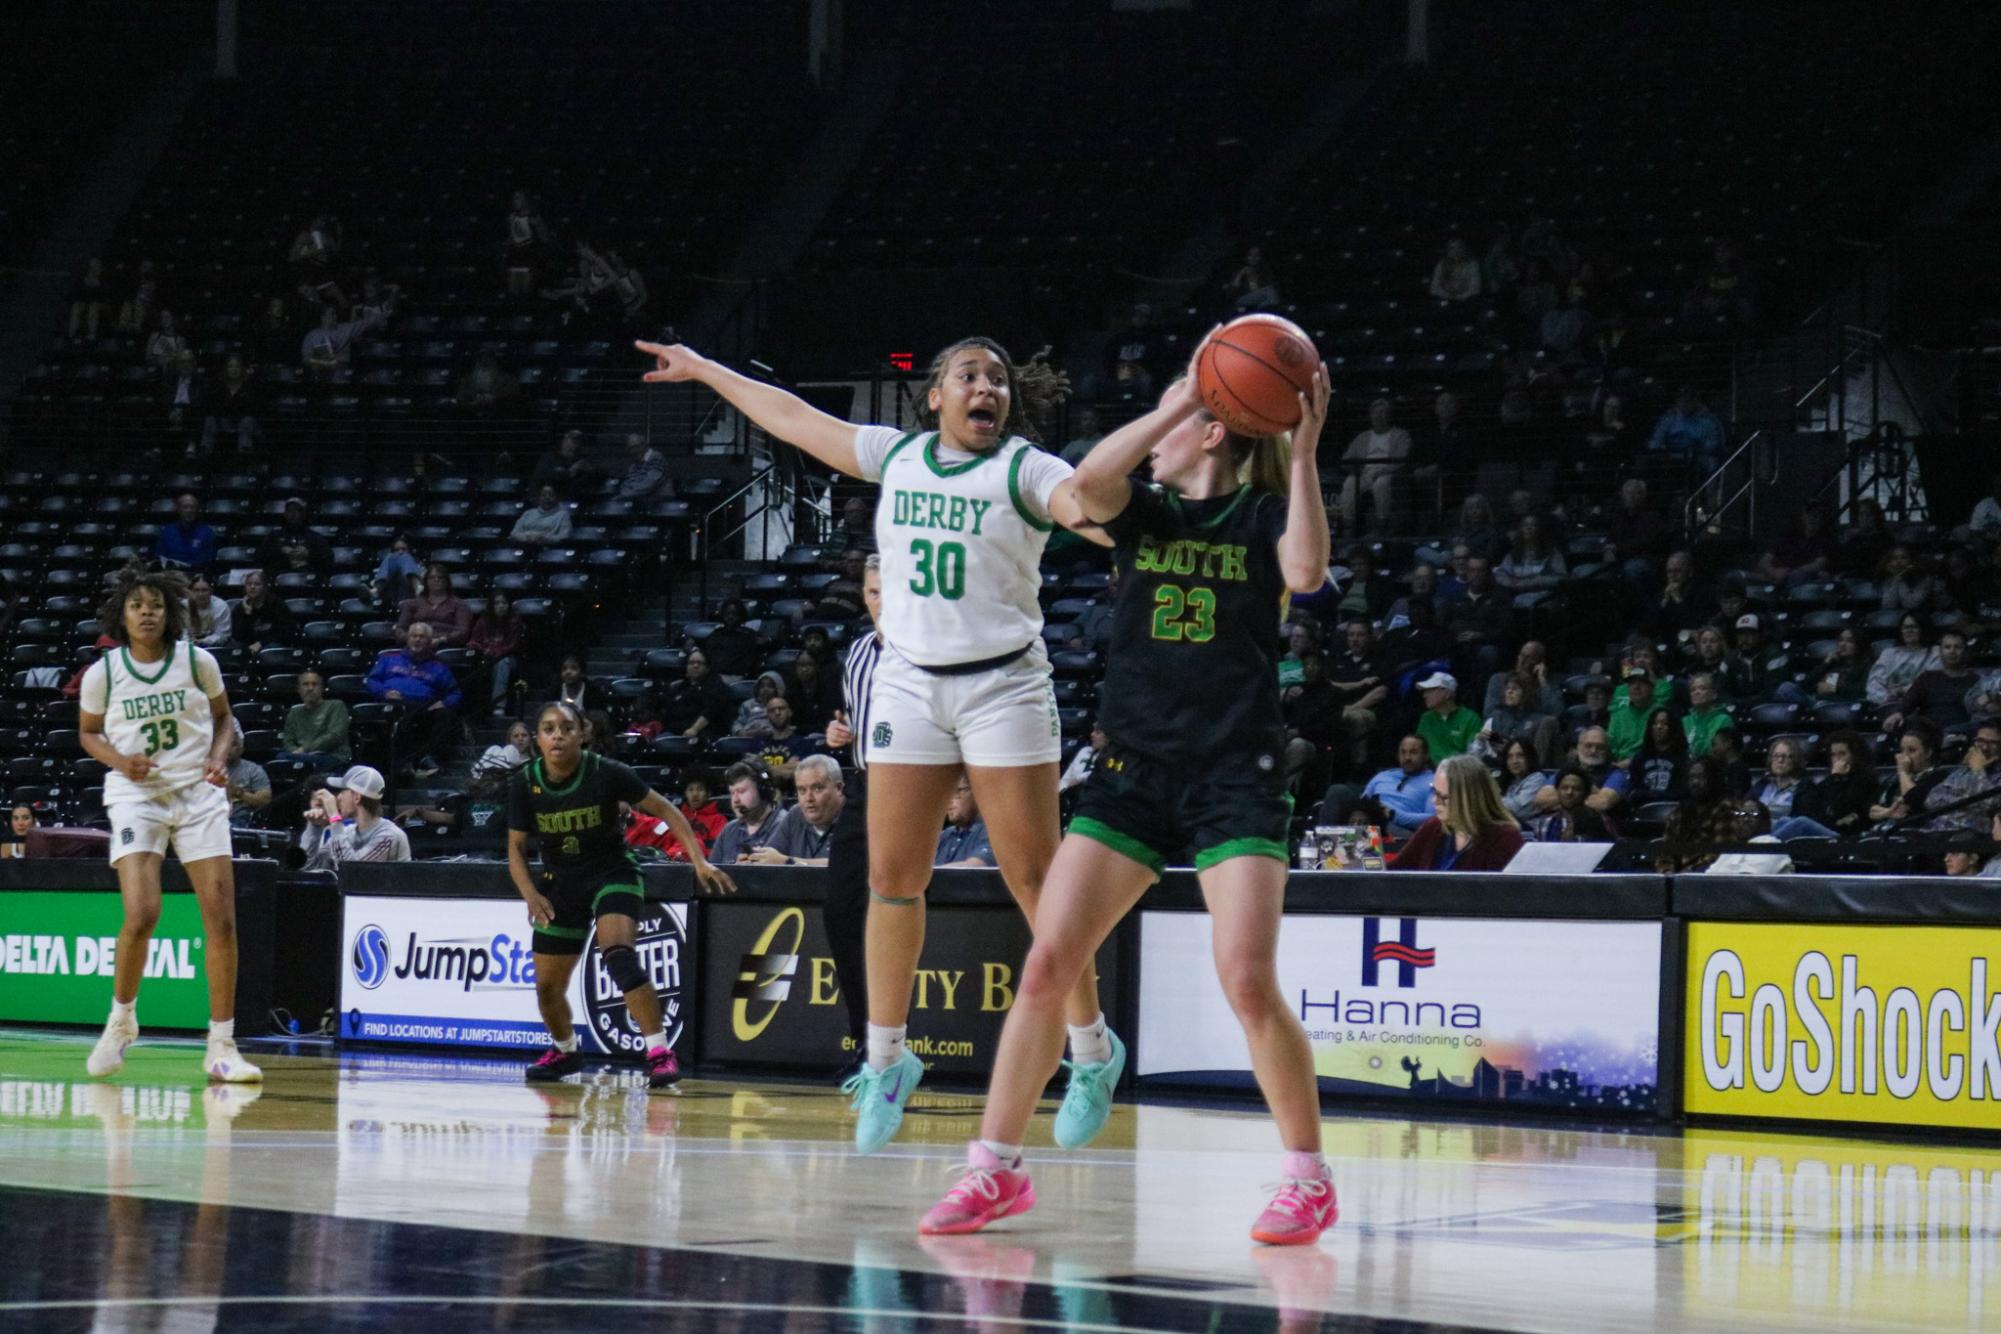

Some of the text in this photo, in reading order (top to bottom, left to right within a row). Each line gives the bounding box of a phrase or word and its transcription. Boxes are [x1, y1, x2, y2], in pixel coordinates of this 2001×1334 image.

[893, 489, 992, 536] DERBY
[909, 538, 967, 601] 30
[1135, 534, 1248, 581] SOUTH
[1151, 583, 1217, 643] 23
[122, 689, 187, 721] DERBY
[140, 718, 179, 757] 33
[536, 805, 602, 834] SOUTH
[75, 936, 196, 979] DETAL
[394, 932, 537, 992] JumpSta
[594, 938, 680, 1001] BTER
[809, 958, 965, 1010] ETY
[364, 1022, 387, 1036] FIND
[389, 1024, 443, 1039] LOCATIONS
[446, 1027, 458, 1039] AT
[1301, 989, 1481, 1029] Hanna
[1305, 1029, 1486, 1049] eating & Air Conditioning Co.
